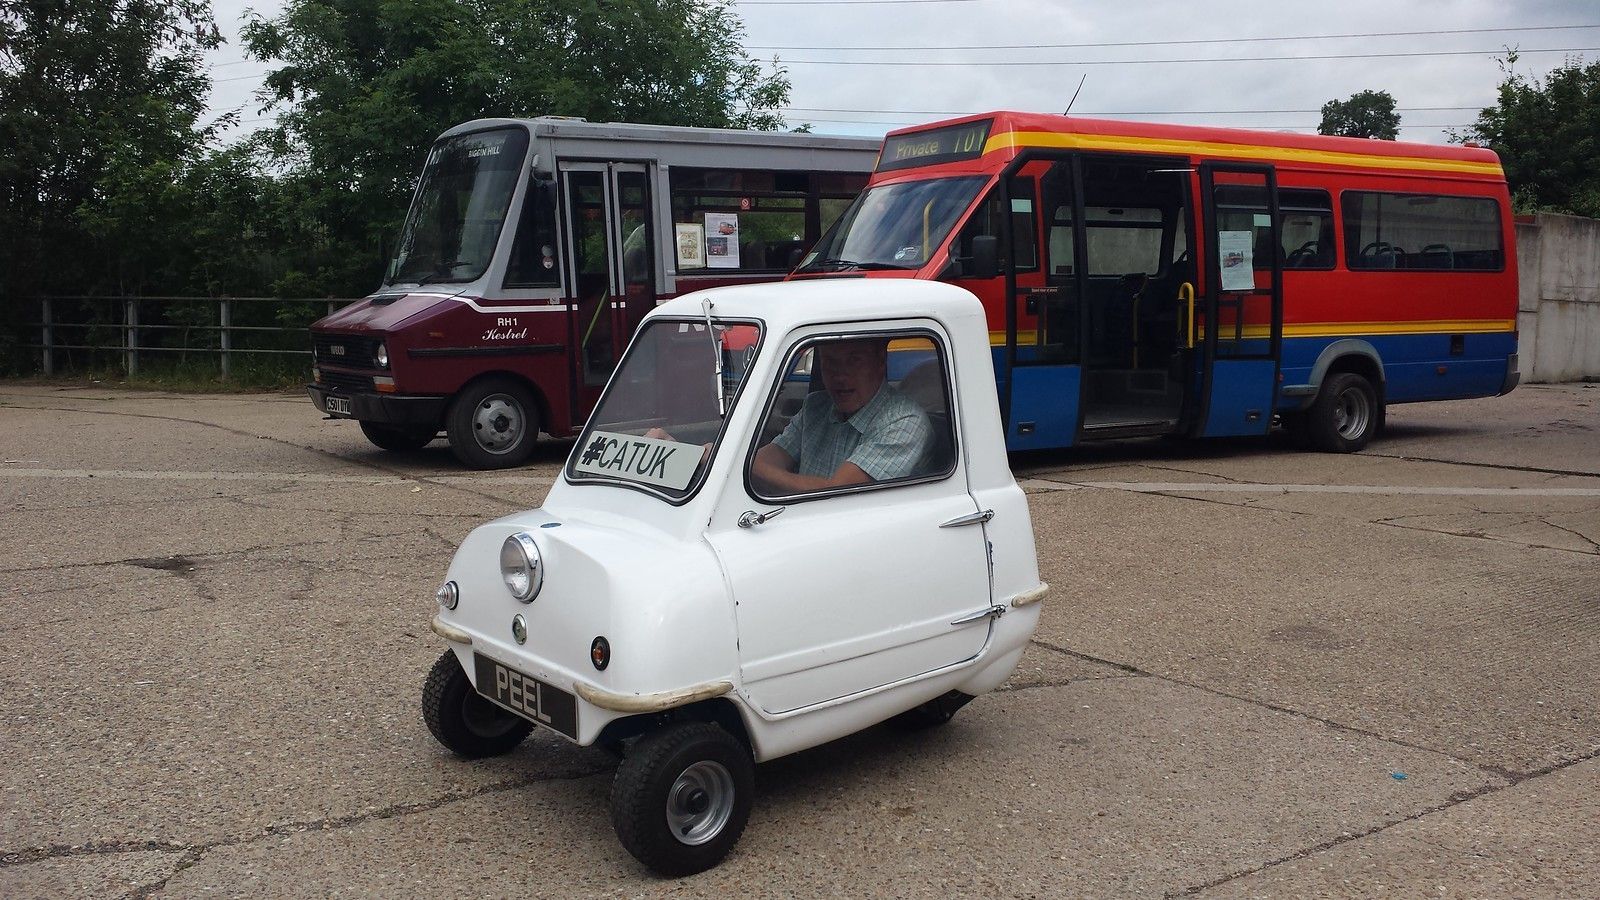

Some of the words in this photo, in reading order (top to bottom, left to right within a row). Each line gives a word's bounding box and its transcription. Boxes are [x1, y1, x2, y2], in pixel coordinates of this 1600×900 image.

[487, 145, 500, 155] HILL
[896, 141, 939, 158] Private
[497, 317, 512, 326] RH
[481, 327, 528, 341] Kestrel
[581, 435, 677, 479] #CATUK
[495, 664, 552, 724] PEEL
